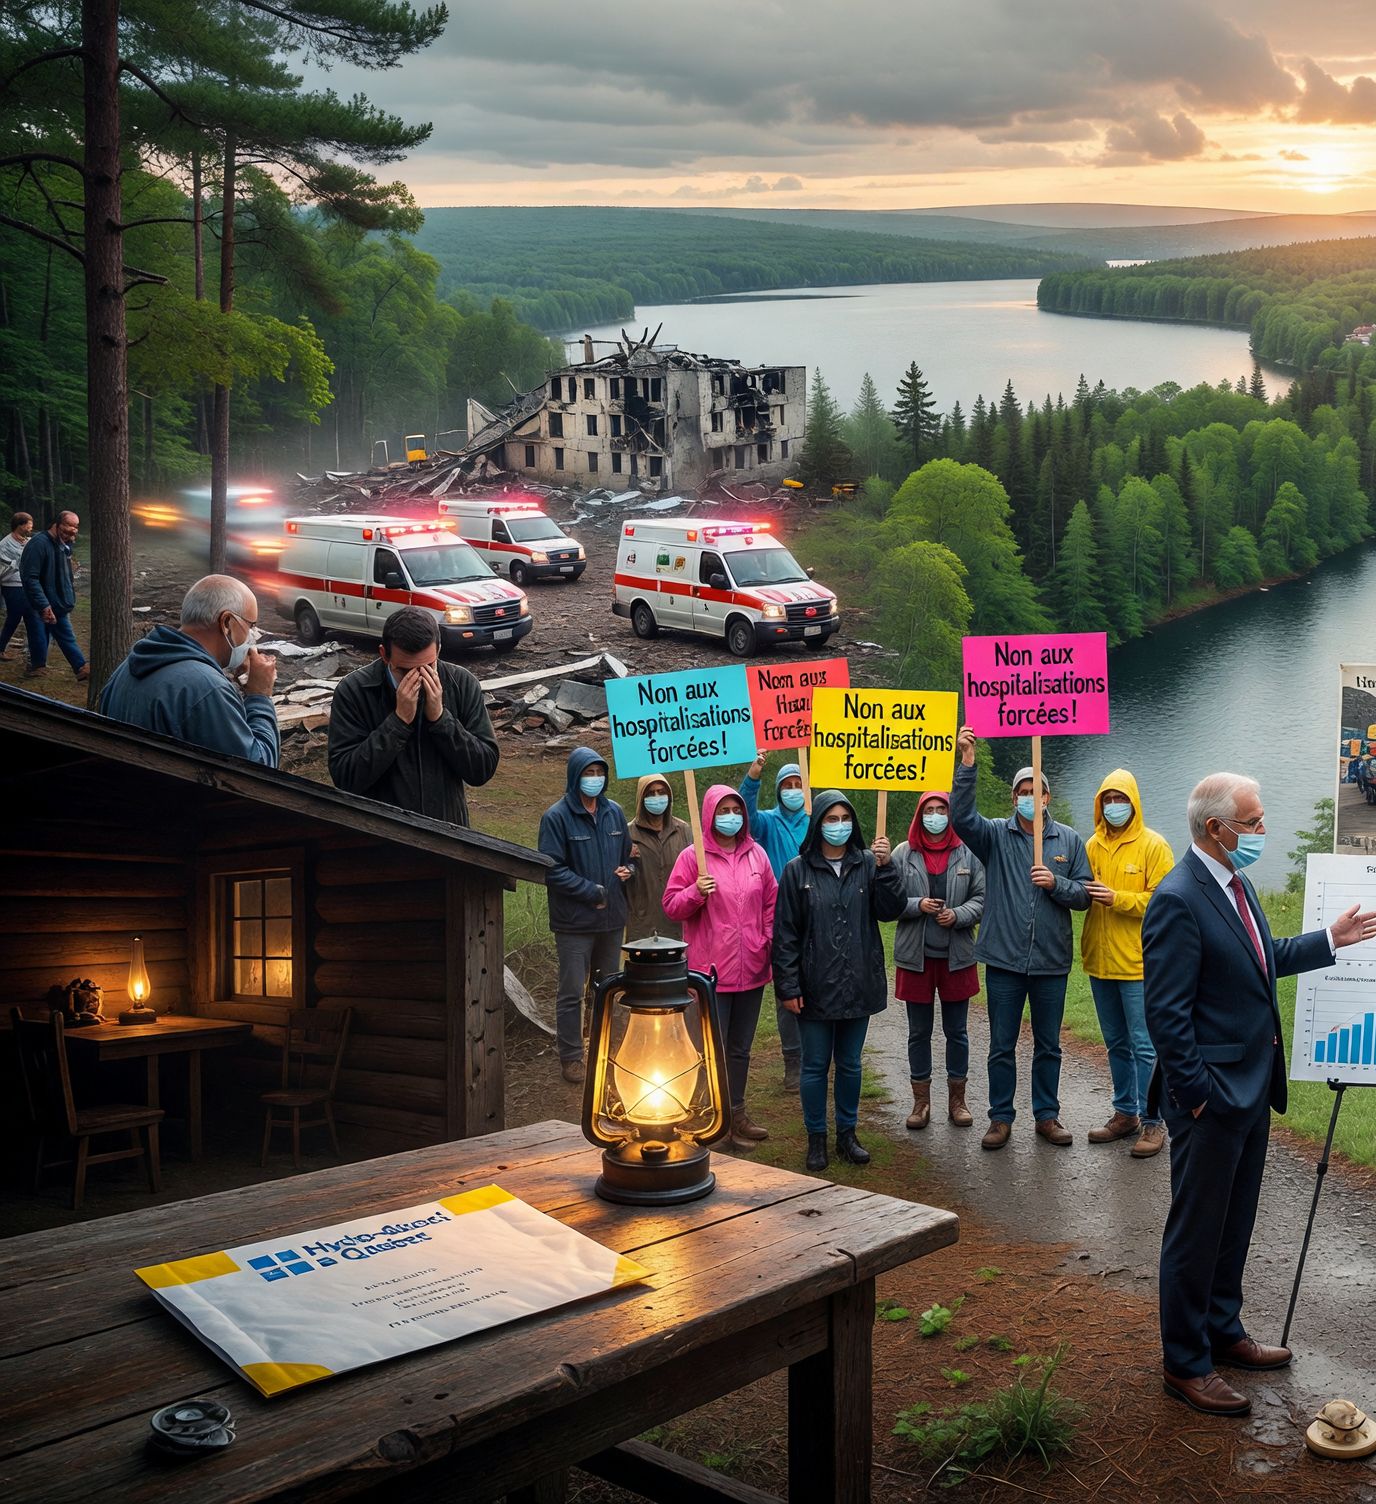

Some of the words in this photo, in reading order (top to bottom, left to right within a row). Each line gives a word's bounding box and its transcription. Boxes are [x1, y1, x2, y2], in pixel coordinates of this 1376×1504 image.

[994, 641, 1033, 667] Non
[1041, 647, 1074, 665] aux
[637, 679, 678, 706] Non
[685, 680, 719, 700] aux
[967, 670, 1106, 701] hospitalisations
[612, 704, 751, 739] hospitalisations
[844, 693, 884, 720] Non
[891, 702, 926, 721] aux
[813, 723, 954, 754] hospitalisations
